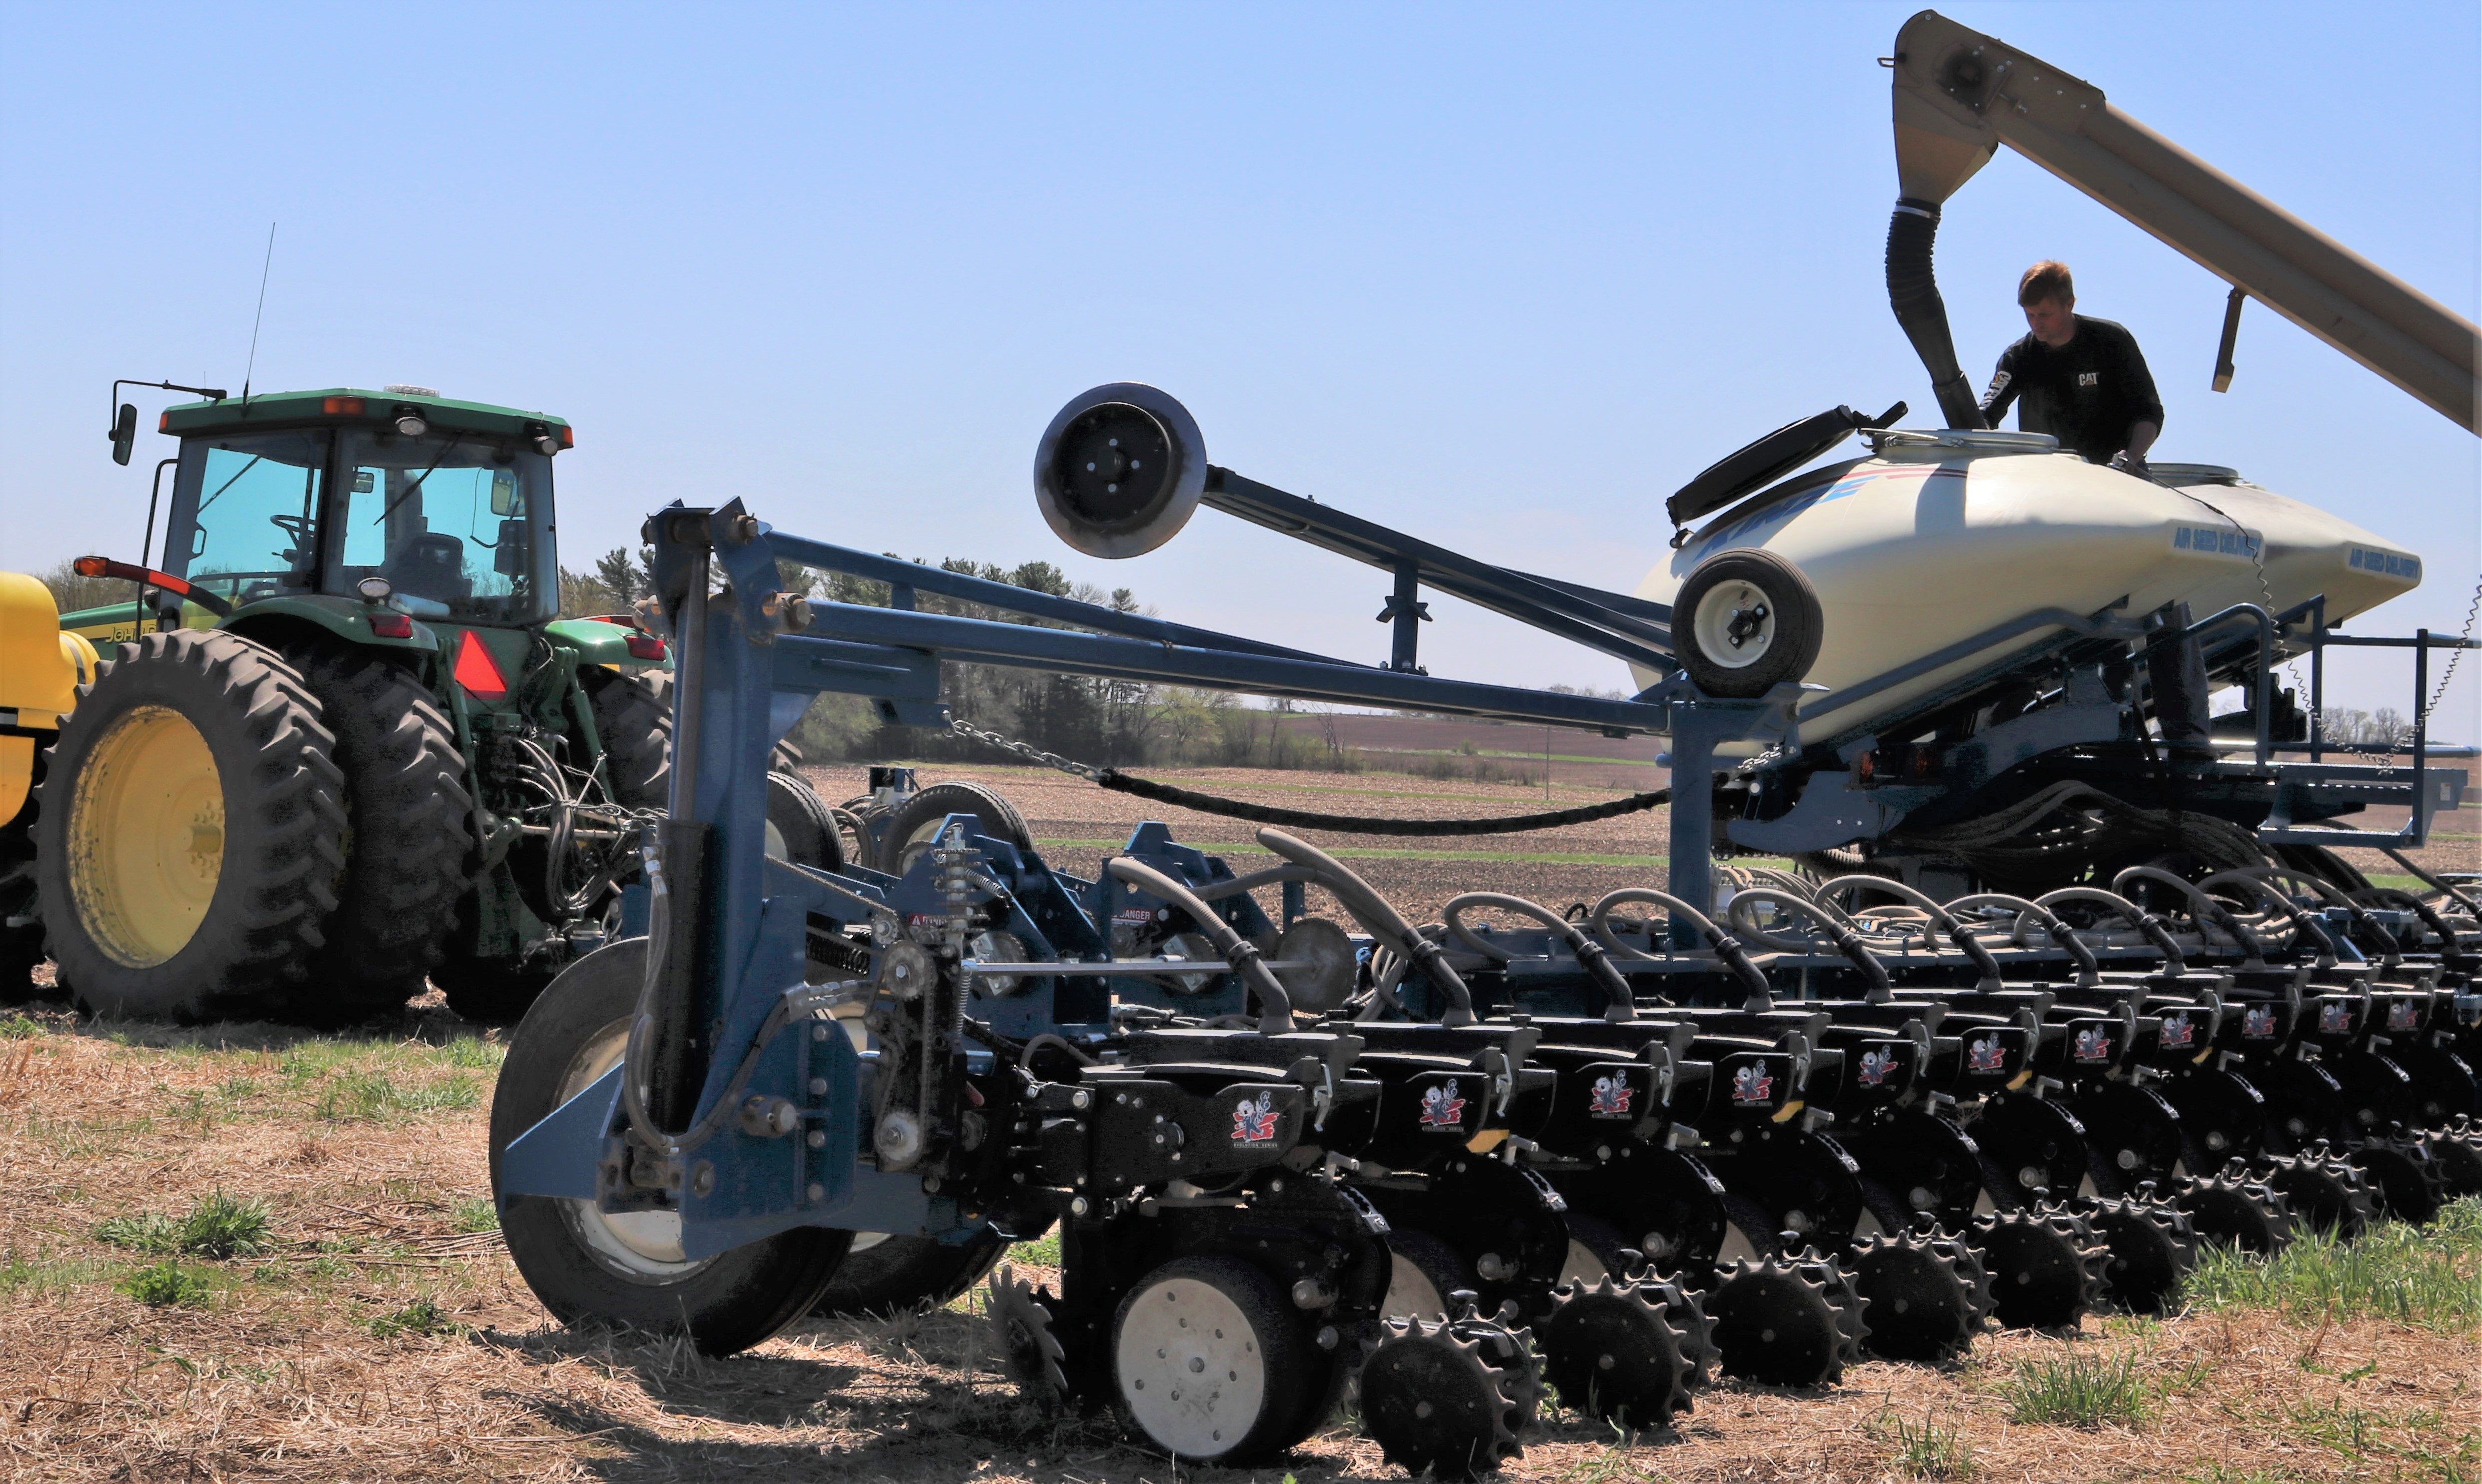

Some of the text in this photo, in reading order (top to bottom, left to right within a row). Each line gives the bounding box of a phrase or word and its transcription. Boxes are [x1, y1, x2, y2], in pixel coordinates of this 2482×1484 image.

[2079, 373, 2097, 386] CAT
[2174, 527, 2262, 558] AIR SEED DELIVERY
[2349, 548, 2420, 579] AIR SEED DELIVERY
